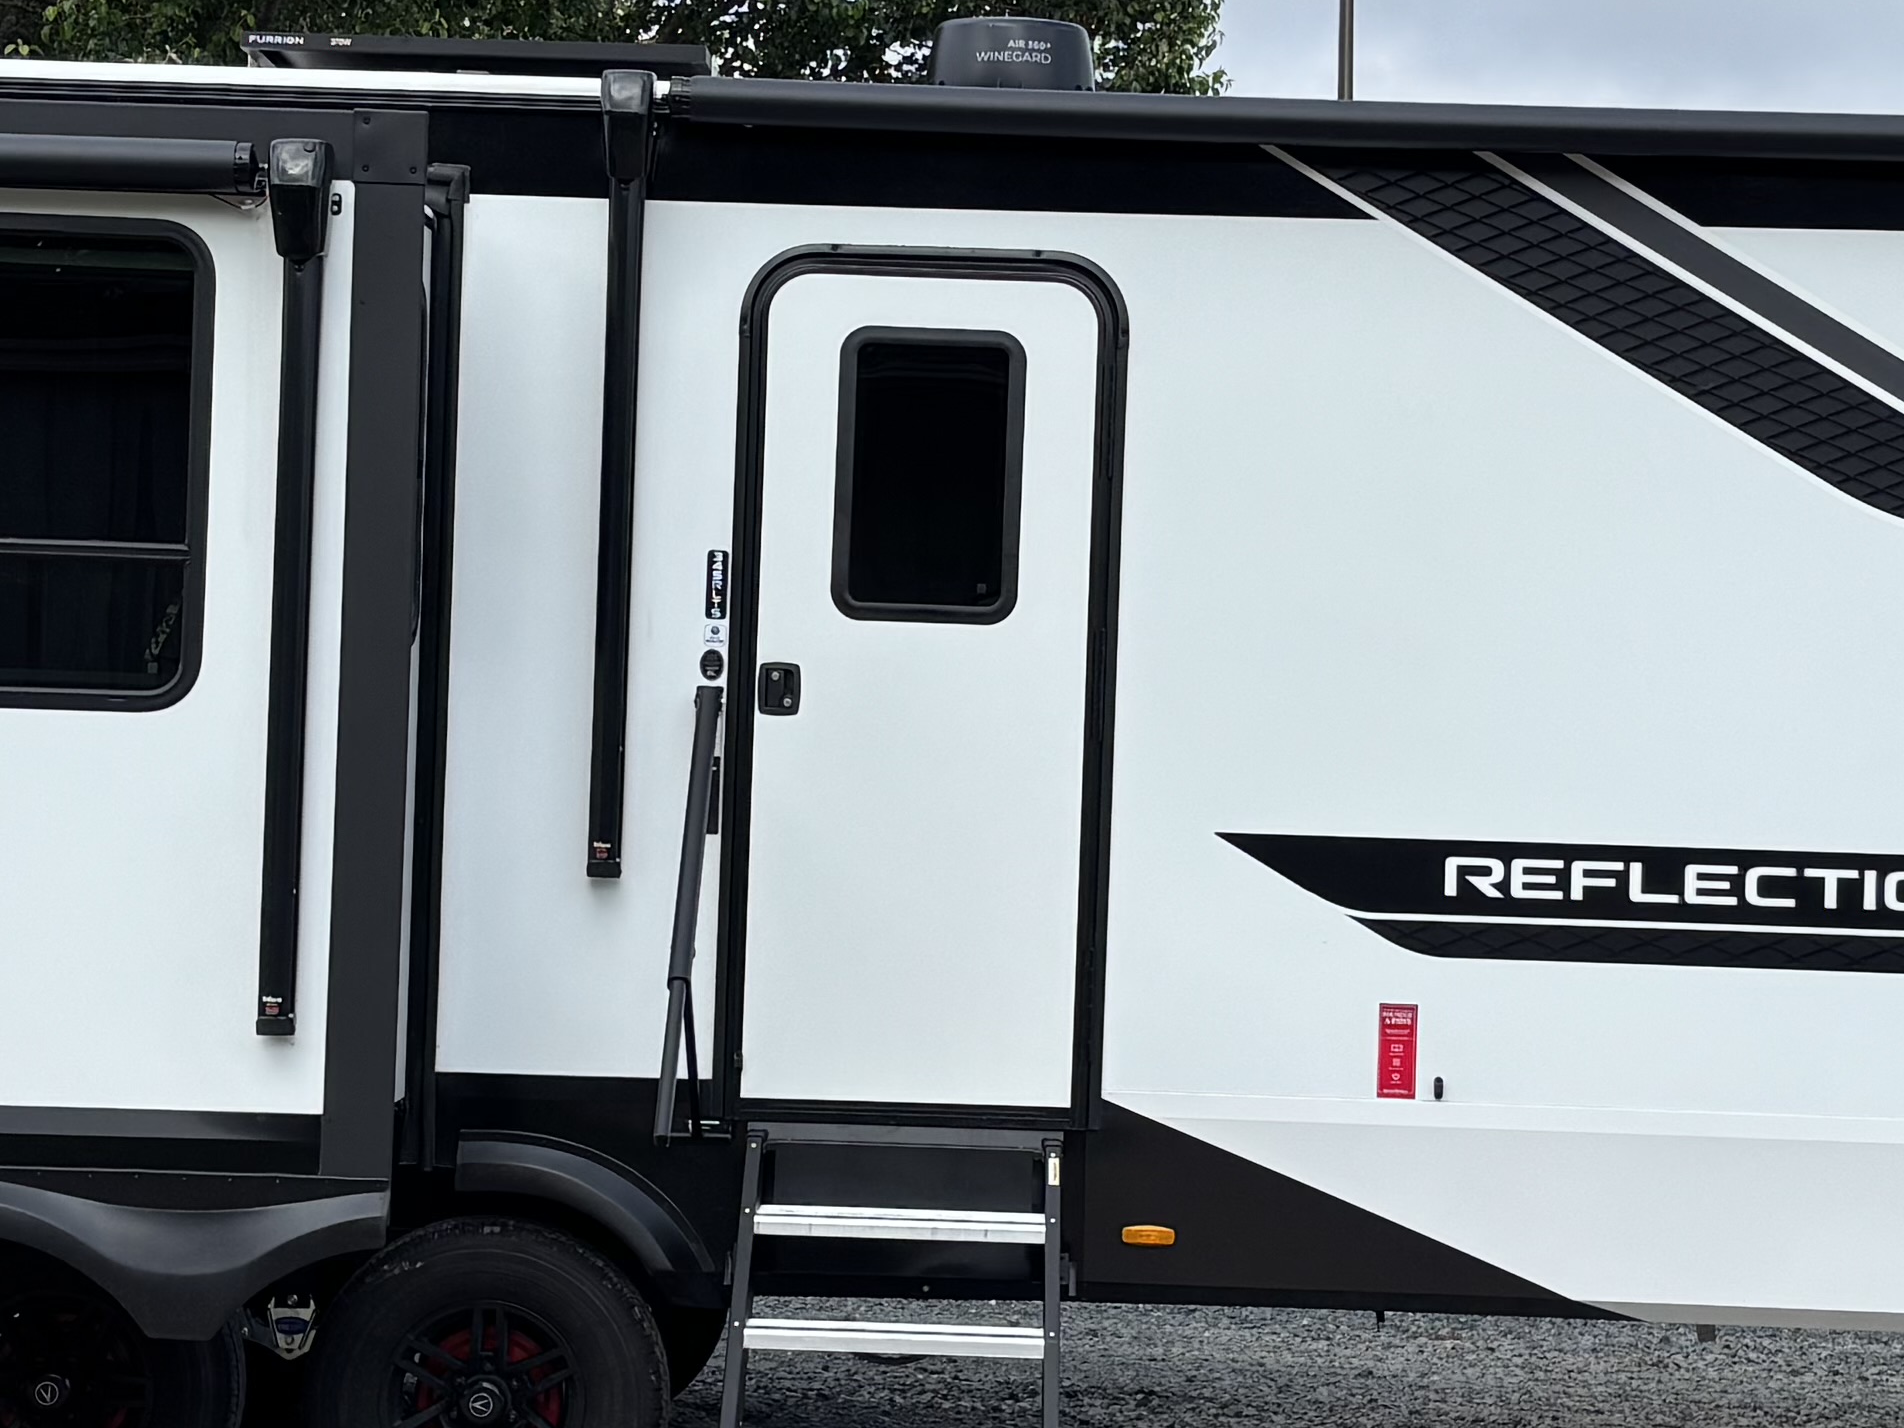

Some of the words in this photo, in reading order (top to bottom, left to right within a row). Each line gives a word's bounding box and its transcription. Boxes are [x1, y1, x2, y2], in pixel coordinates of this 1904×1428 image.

[248, 34, 304, 45] FURRION
[1007, 39, 1026, 49] AIR
[976, 51, 1052, 64] WINEGARD
